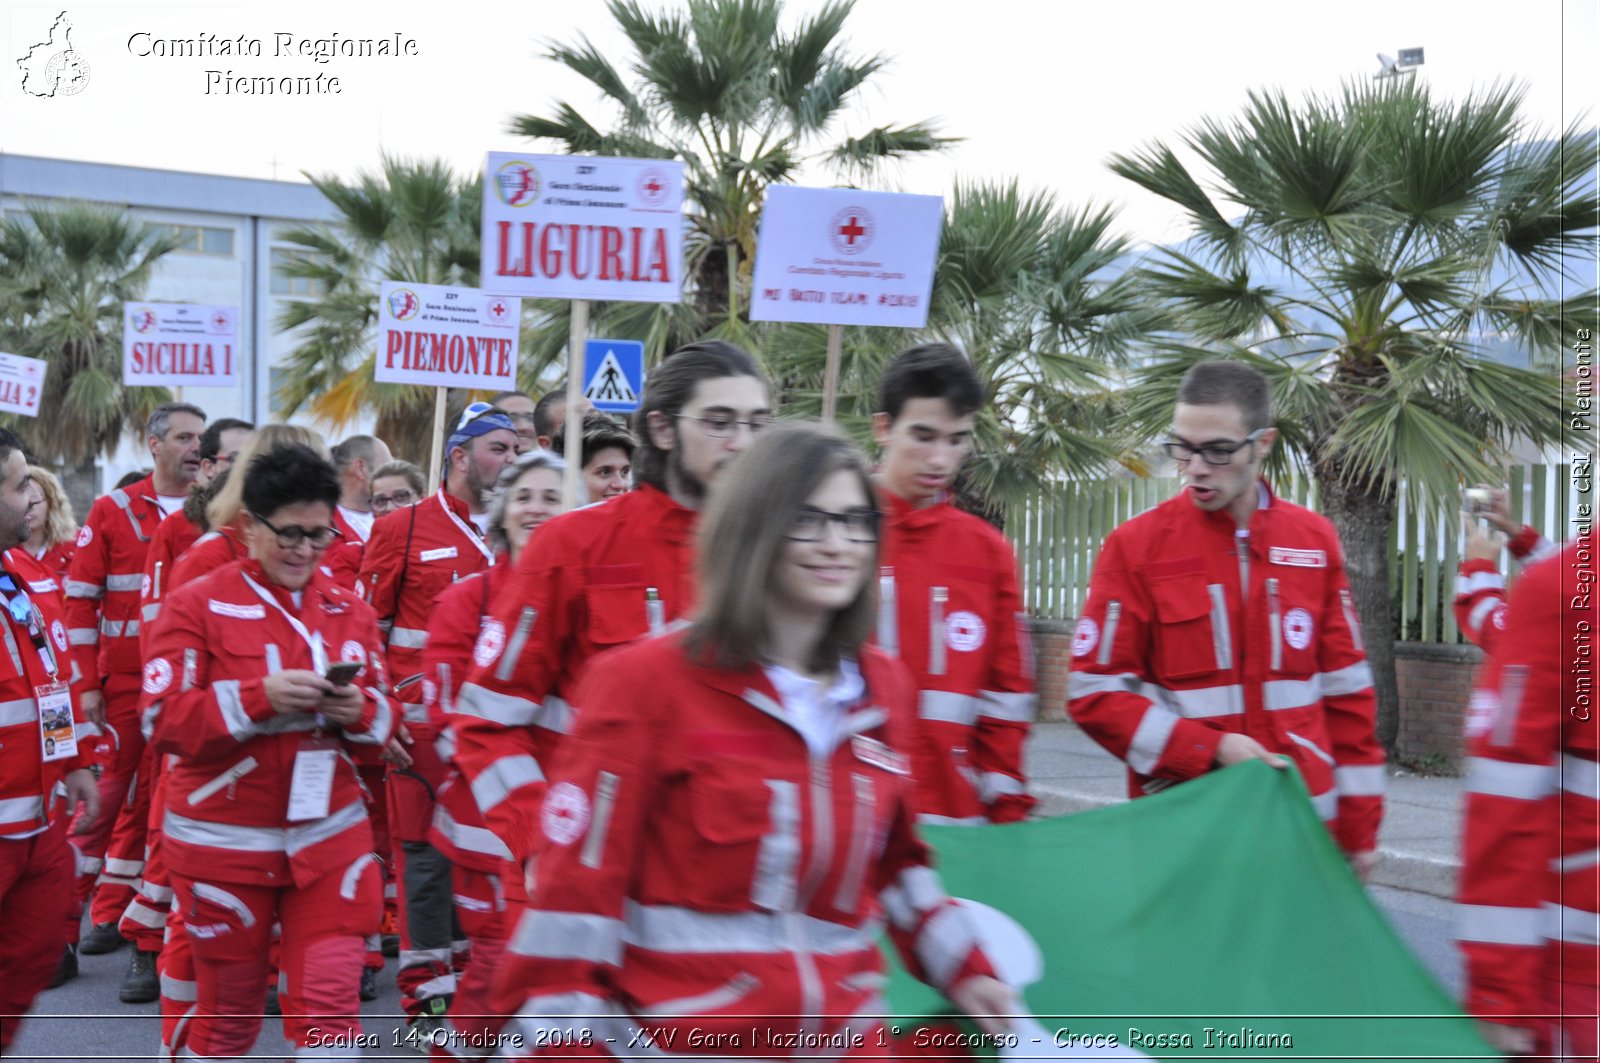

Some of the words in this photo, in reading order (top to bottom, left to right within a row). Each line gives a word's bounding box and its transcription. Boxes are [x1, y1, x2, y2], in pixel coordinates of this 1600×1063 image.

[496, 220, 671, 283] LIGURIA
[130, 341, 215, 376] SICILIA
[385, 330, 512, 377] PIEMONTE
[26, 385, 37, 407] 2
